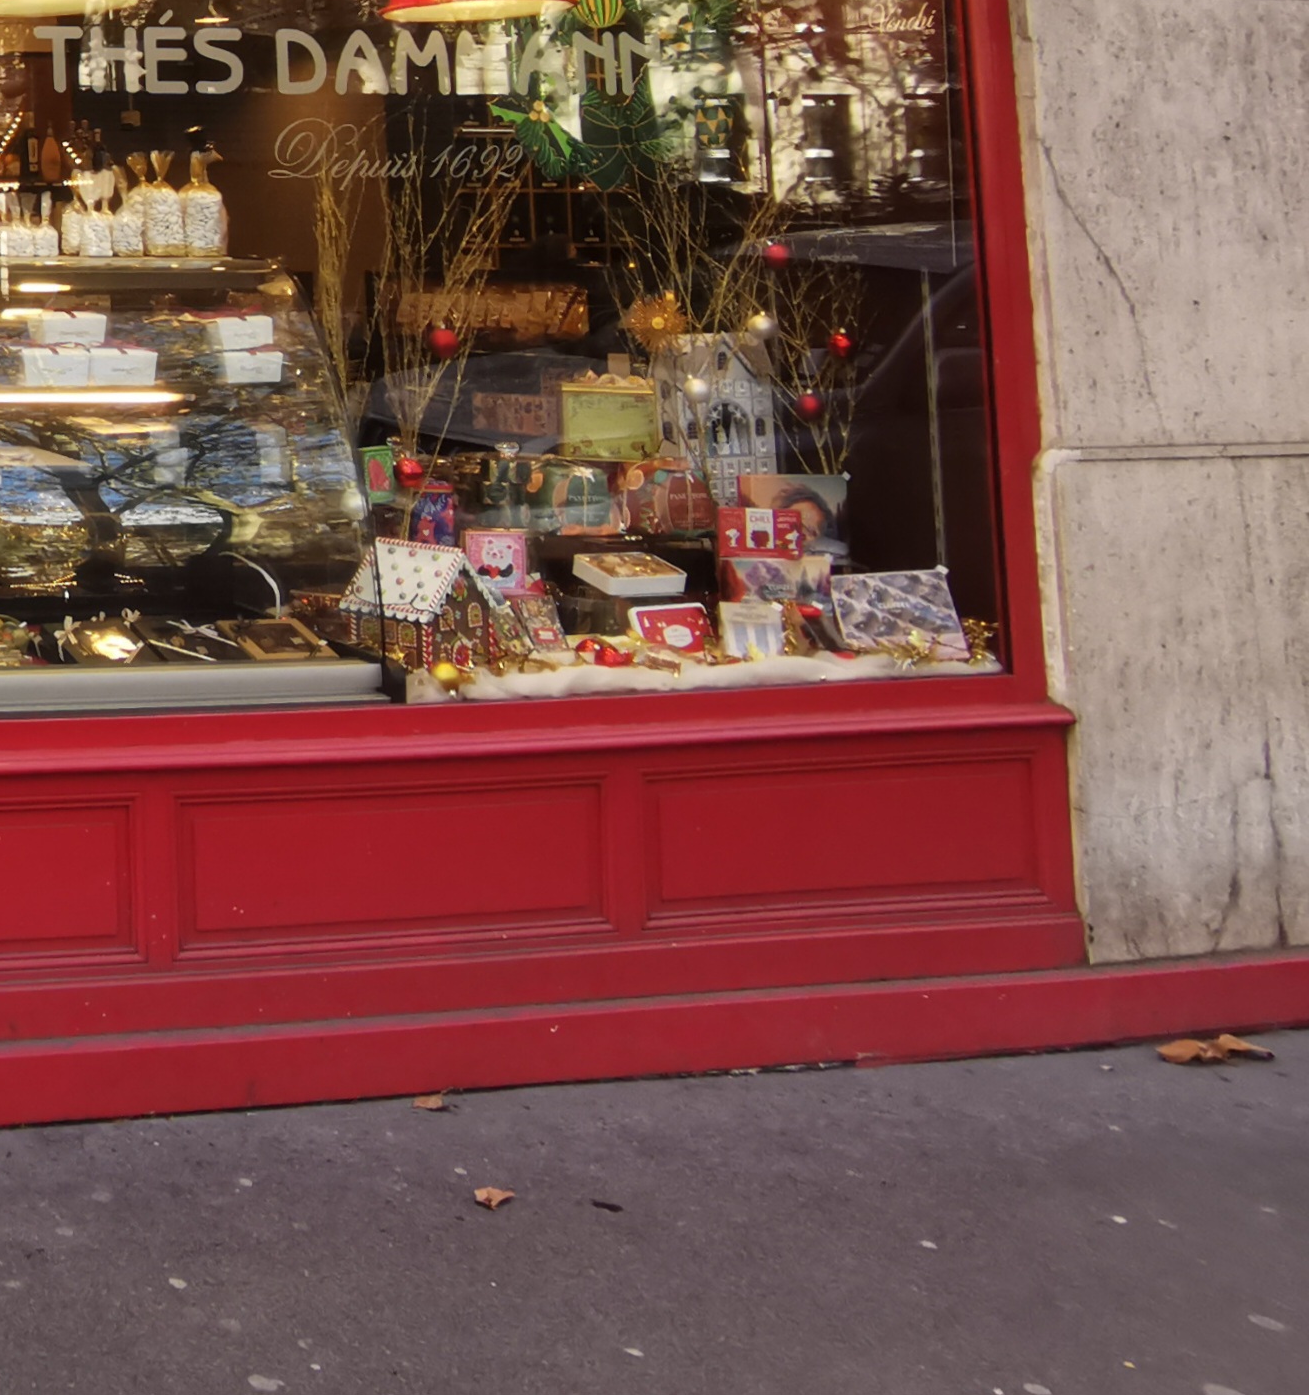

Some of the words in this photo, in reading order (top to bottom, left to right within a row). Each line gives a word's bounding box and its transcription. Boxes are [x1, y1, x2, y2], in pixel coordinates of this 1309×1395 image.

[34, 10, 242, 95] THÉS
[268, 118, 417, 193] Depuis
[430, 144, 523, 179] 1692
